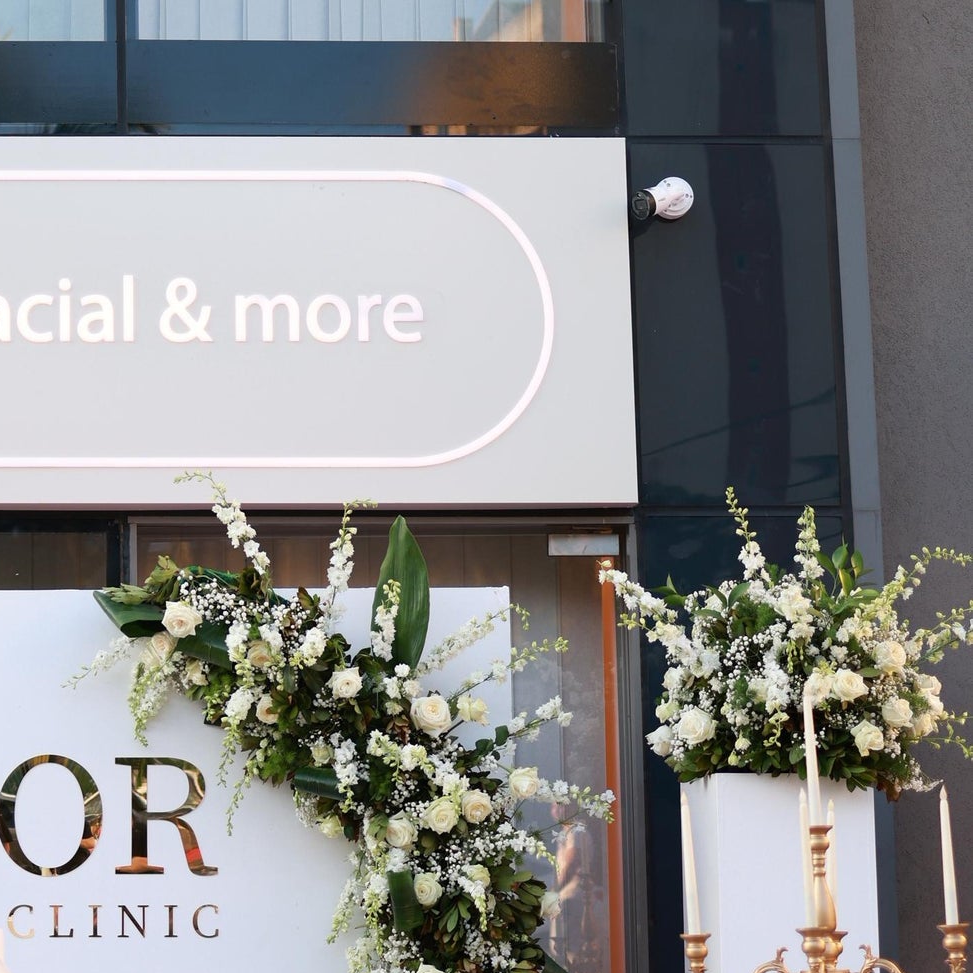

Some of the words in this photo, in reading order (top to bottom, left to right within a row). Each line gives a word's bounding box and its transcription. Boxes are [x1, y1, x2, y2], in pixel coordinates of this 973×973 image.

[158, 275, 214, 344] &
[233, 293, 425, 343] more
[6, 903, 222, 940] CLINIC
